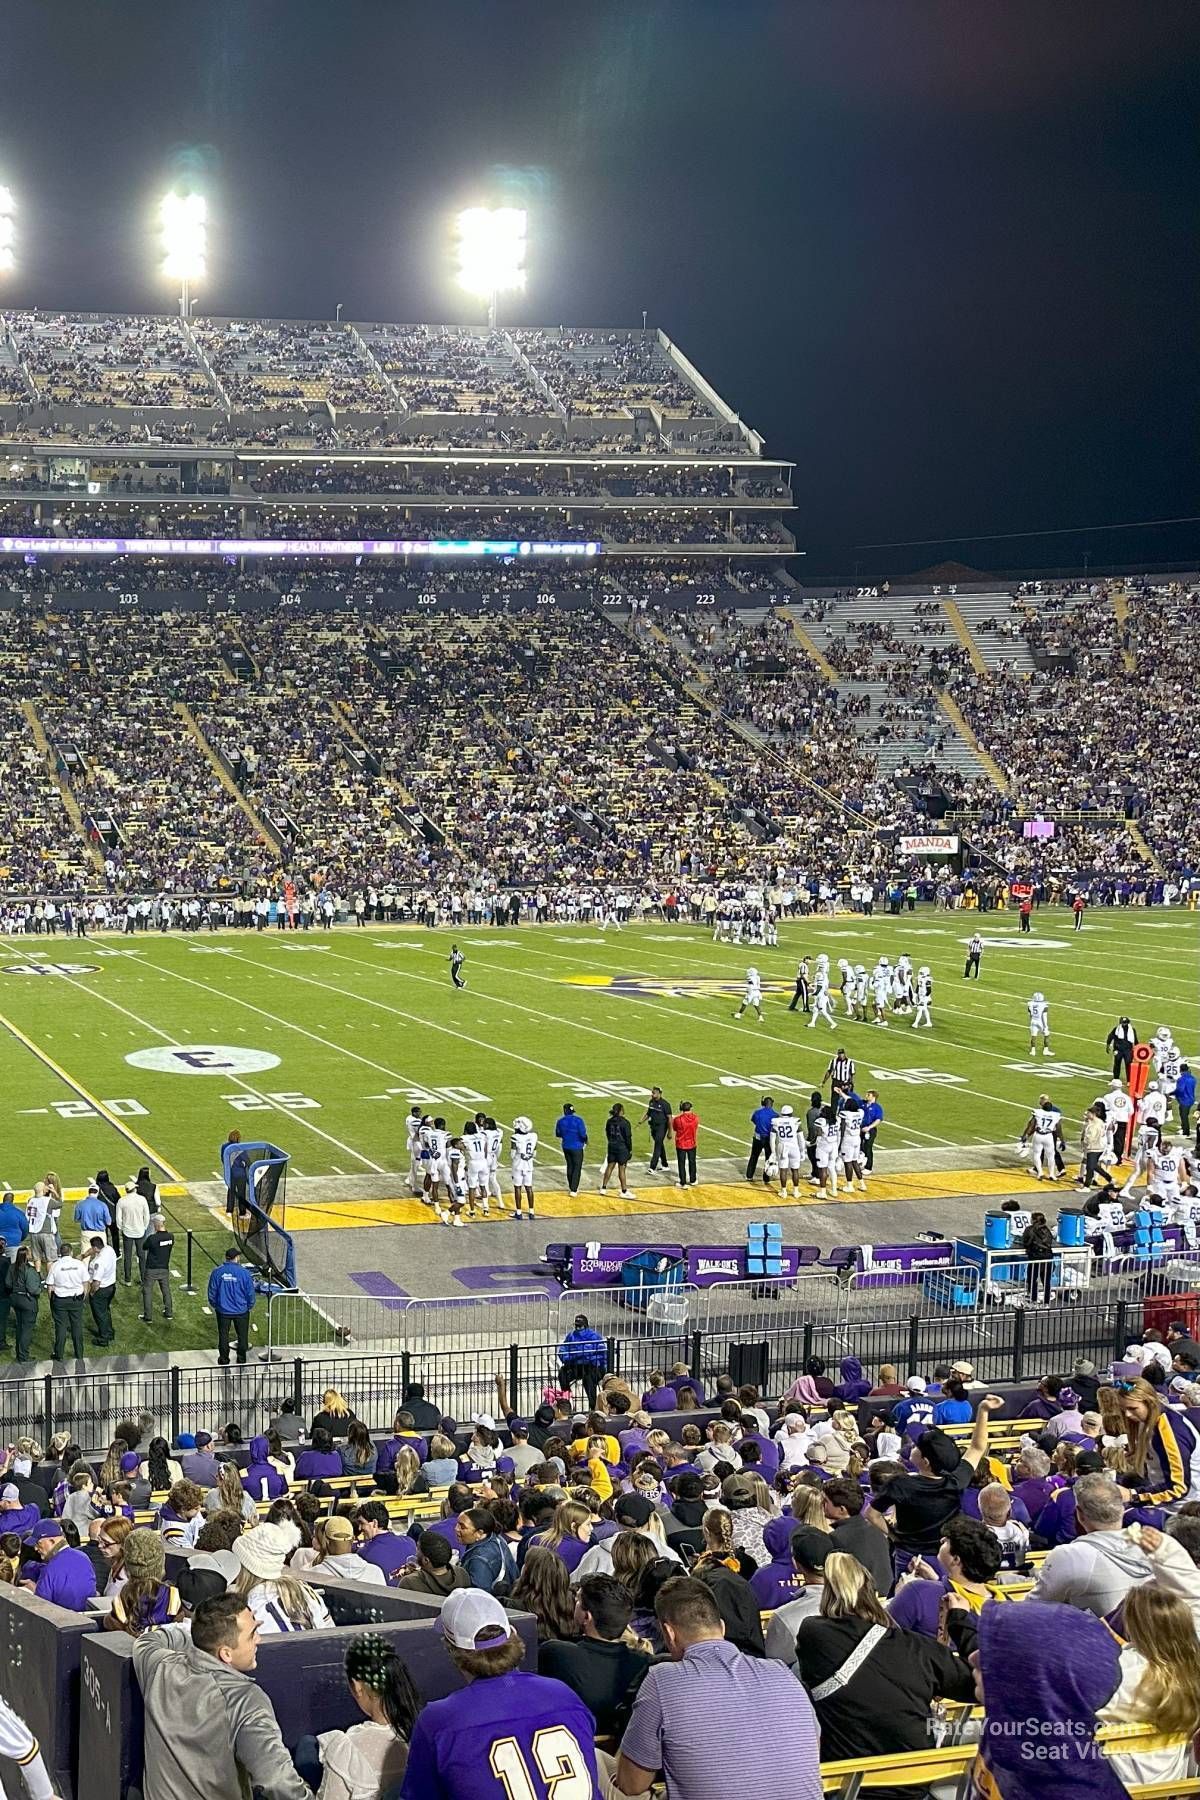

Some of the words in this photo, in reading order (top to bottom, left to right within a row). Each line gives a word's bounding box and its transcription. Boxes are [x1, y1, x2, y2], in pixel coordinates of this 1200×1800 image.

[287, 543, 319, 553] HEALTH
[320, 543, 363, 553] PARTNERS
[857, 587, 878, 598] 224
[119, 594, 138, 604] 103
[281, 594, 301, 605] 104
[417, 594, 437, 604] 105
[536, 594, 556, 604] 106
[602, 594, 622, 605] 222
[696, 594, 715, 605] 223
[905, 837, 952, 850] MANDA
[869, 1067, 970, 1084] 45
[1001, 1062, 1112, 1077] 50
[718, 1074, 820, 1091] 40
[385, 1086, 495, 1104] 30
[548, 1080, 653, 1098] 35
[219, 1092, 324, 1111] 25
[49, 1098, 151, 1119] 20
[1041, 1117, 1053, 1127] 17
[778, 1126, 794, 1138] 82
[431, 1139, 438, 1151] 8
[473, 1141, 482, 1152] 11
[526, 1143, 532, 1154] 6
[1161, 1160, 1176, 1172] 60
[1014, 1215, 1030, 1229] 88
[1110, 1210, 1125, 1225] 52
[593, 1259, 623, 1268] BRIDGE
[698, 1259, 738, 1270] WALK-ON'S
[911, 1256, 951, 1267] SouthernAIR
[260, 1477, 270, 1500] 1
[84, 1655, 112, 1735] 305-A
[488, 1724, 593, 1800] 12
